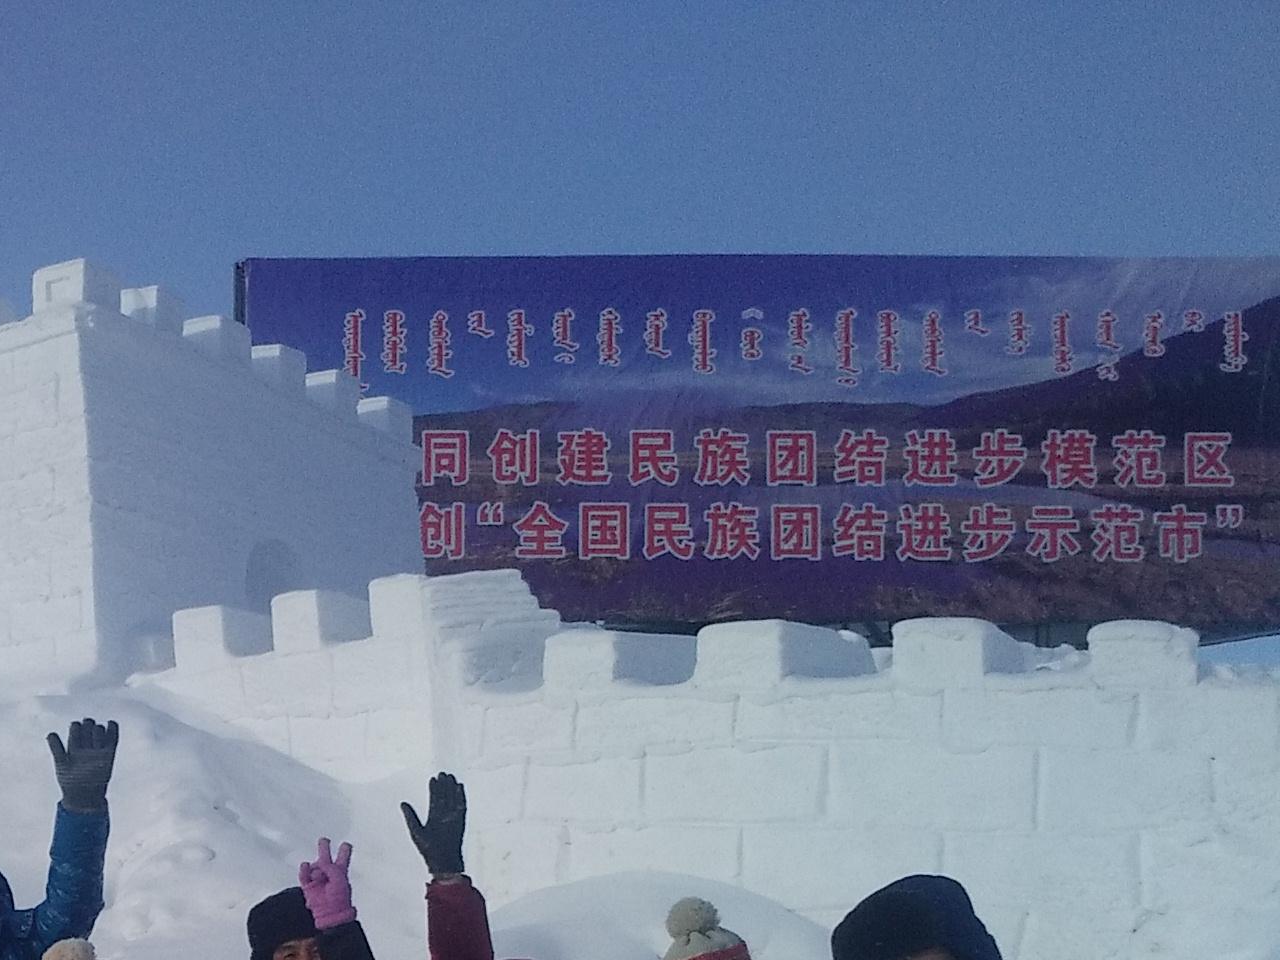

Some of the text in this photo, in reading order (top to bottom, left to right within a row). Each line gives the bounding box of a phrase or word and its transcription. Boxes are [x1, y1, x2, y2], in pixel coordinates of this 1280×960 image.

[422, 429, 1235, 488] 同创建民族团结进步模范区
[420, 501, 1243, 563] 创“全国民族团结进步示范市”
